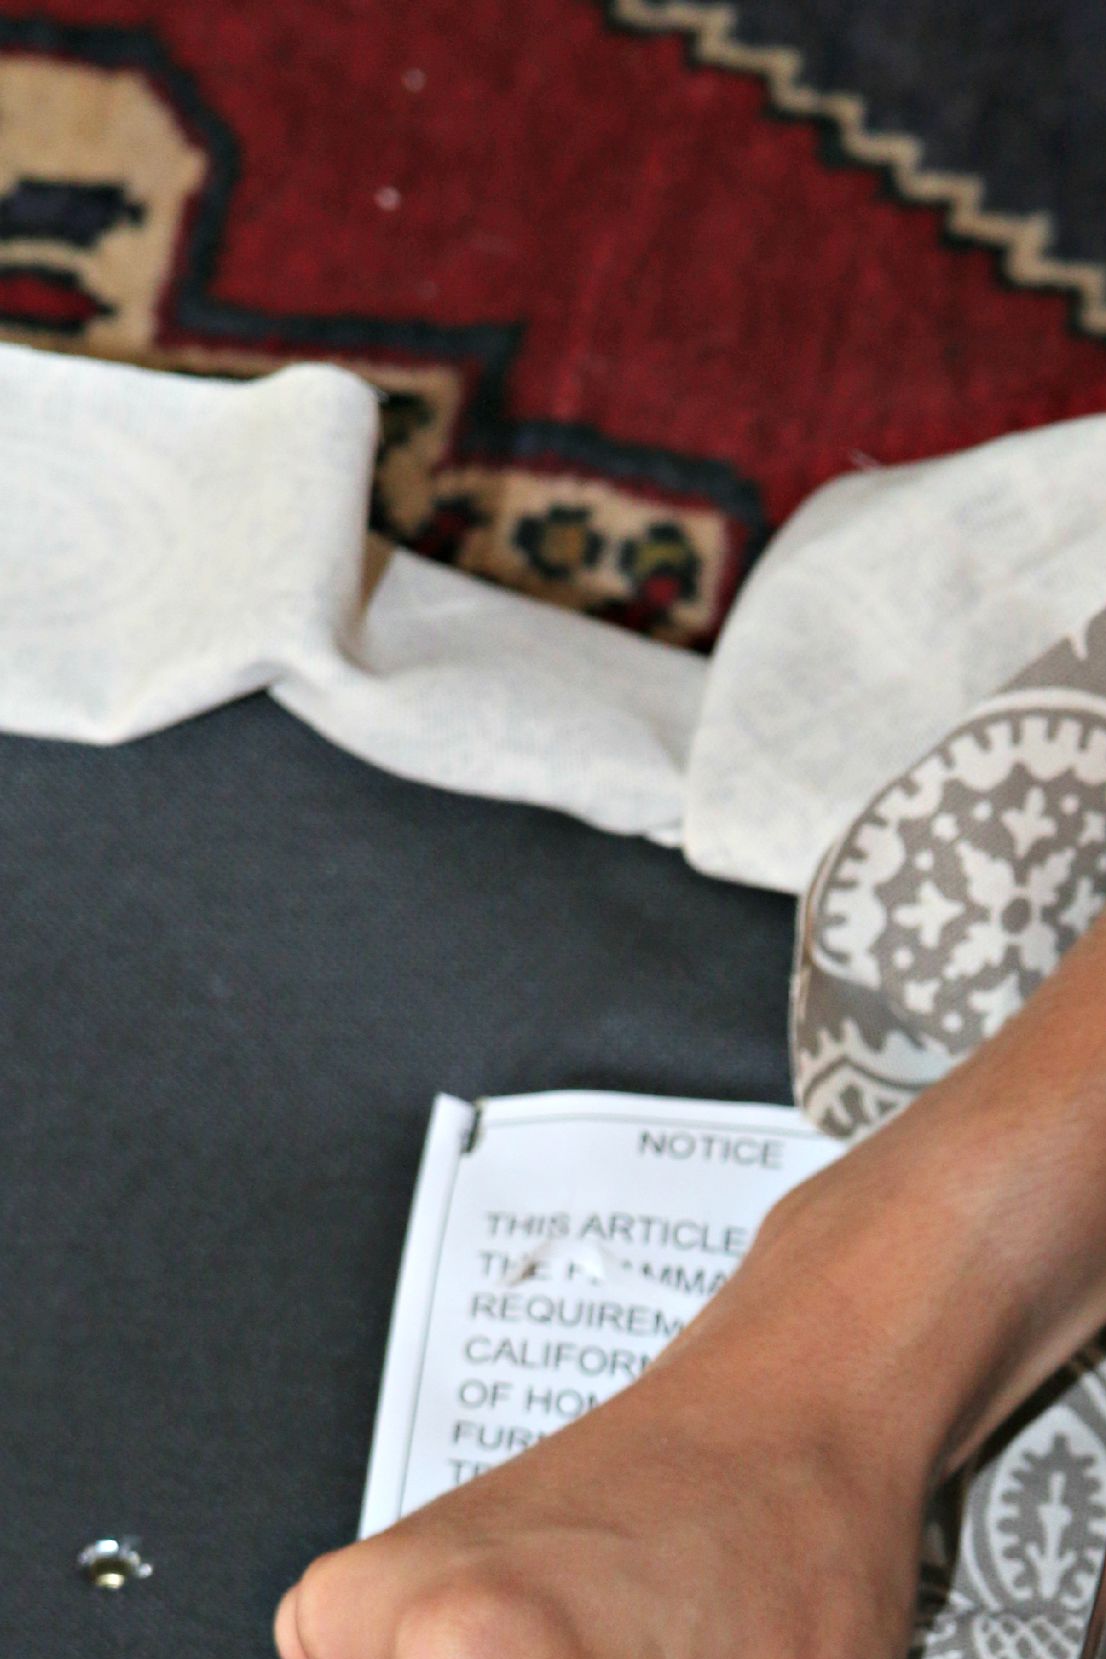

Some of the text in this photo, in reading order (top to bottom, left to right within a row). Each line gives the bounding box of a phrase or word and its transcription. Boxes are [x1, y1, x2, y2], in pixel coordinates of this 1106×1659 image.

[637, 1129, 785, 1170] NOTICE
[486, 1210, 748, 1256] THIS ARTICLE
[457, 1377, 513, 1409] OF
